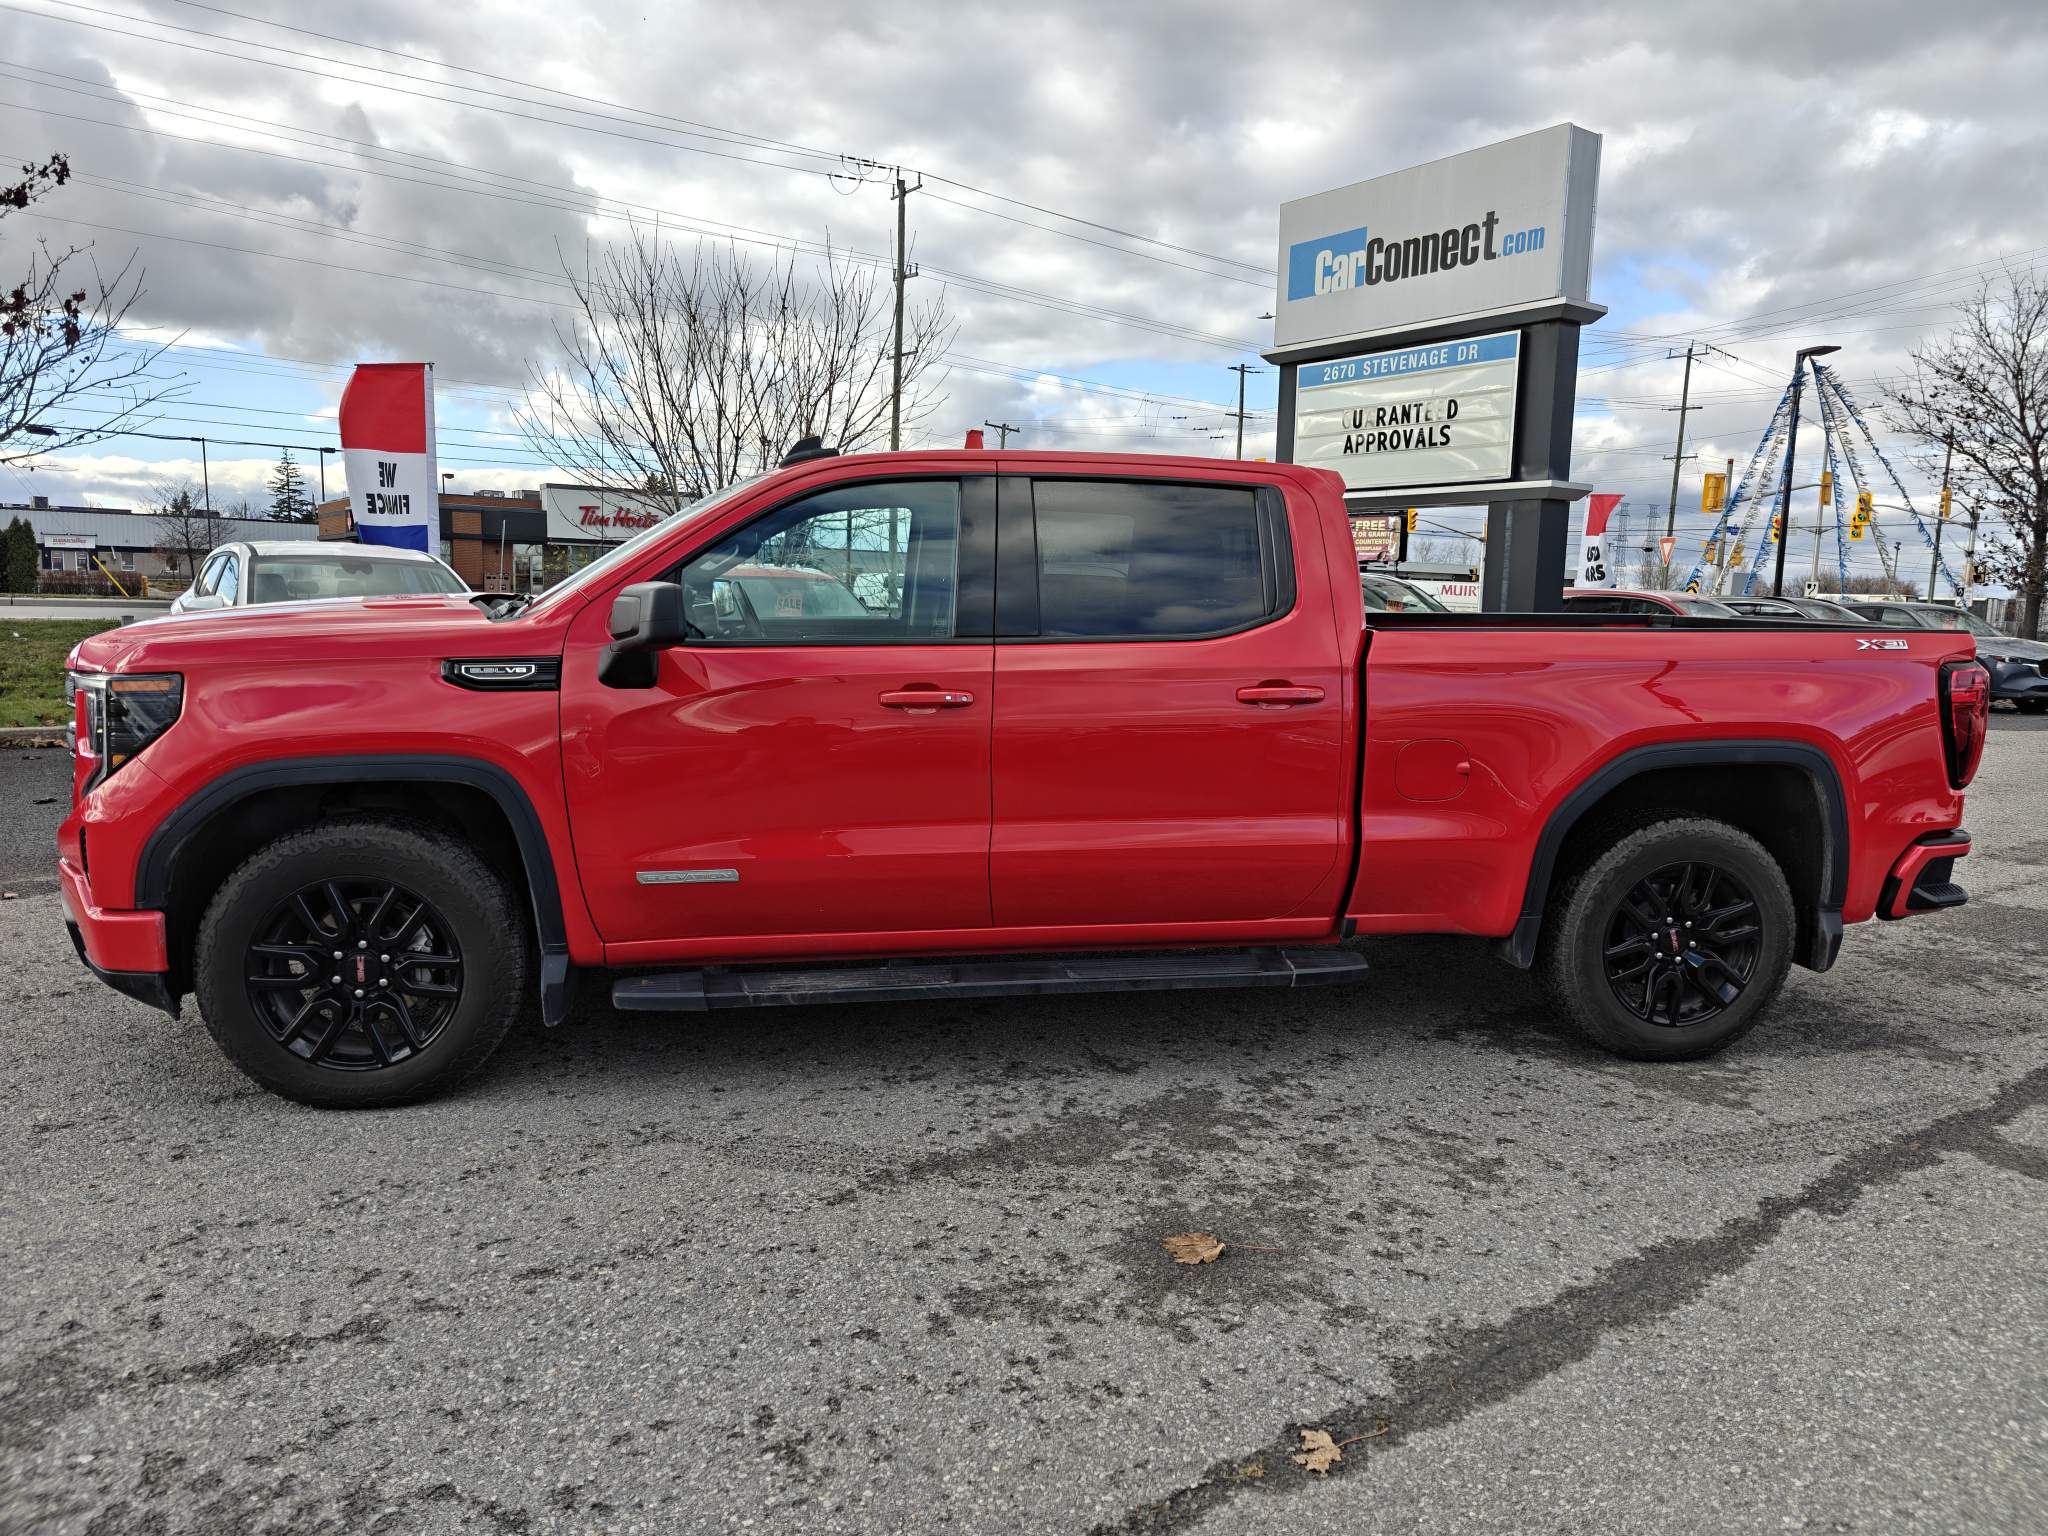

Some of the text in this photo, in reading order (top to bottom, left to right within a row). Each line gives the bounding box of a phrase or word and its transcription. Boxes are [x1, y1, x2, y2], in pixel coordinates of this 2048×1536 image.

[1314, 210, 1546, 297] CarConnect.com
[1323, 344, 1479, 381] 2670 STEVENAGE DR
[1343, 424, 1452, 454] APPROVALS
[578, 506, 611, 527] Tim
[1355, 520, 1386, 531] FREE
